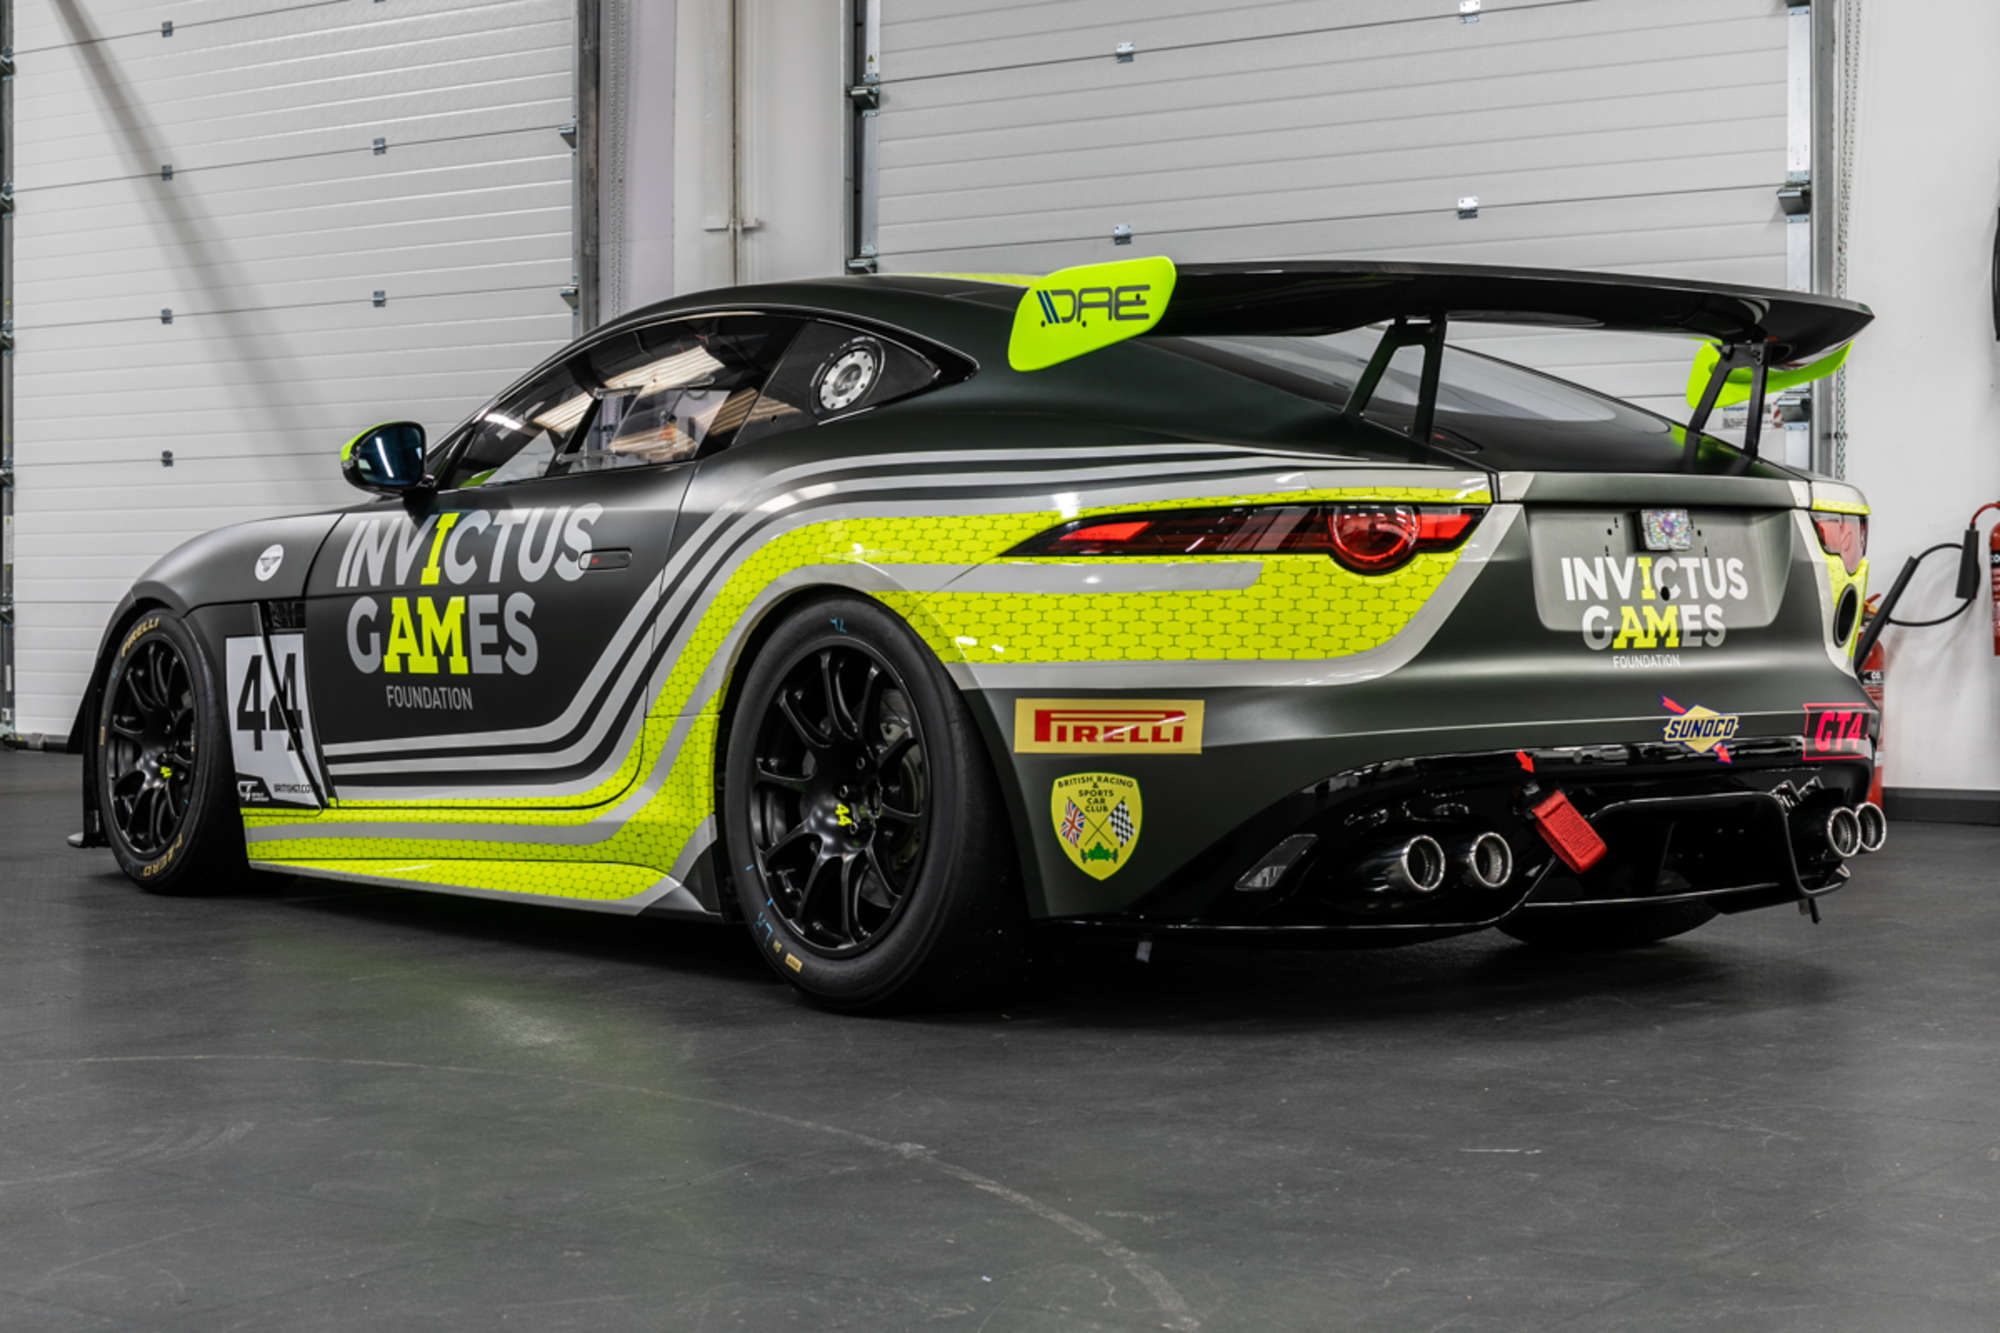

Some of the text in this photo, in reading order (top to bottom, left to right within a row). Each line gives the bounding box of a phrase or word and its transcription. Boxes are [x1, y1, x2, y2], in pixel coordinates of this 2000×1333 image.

[335, 502, 603, 588] INVICTUS
[1561, 556, 1749, 601] INVICTUS
[346, 591, 539, 676] GAMES
[1582, 604, 1726, 650] GAMES
[1612, 654, 1681, 669] FOUNDATION
[237, 653, 304, 752] 44
[386, 685, 473, 710] FOUNDATION
[1034, 709, 1187, 743] PIRELLI
[1667, 719, 1736, 738] SUNOCO
[1815, 711, 1864, 752] GT4
[1058, 776, 1134, 788] BRITISH RACING
[1078, 789, 1114, 797] SPORTS
[1085, 805, 1109, 813] CLUB
[1086, 798, 1106, 806] CAR
